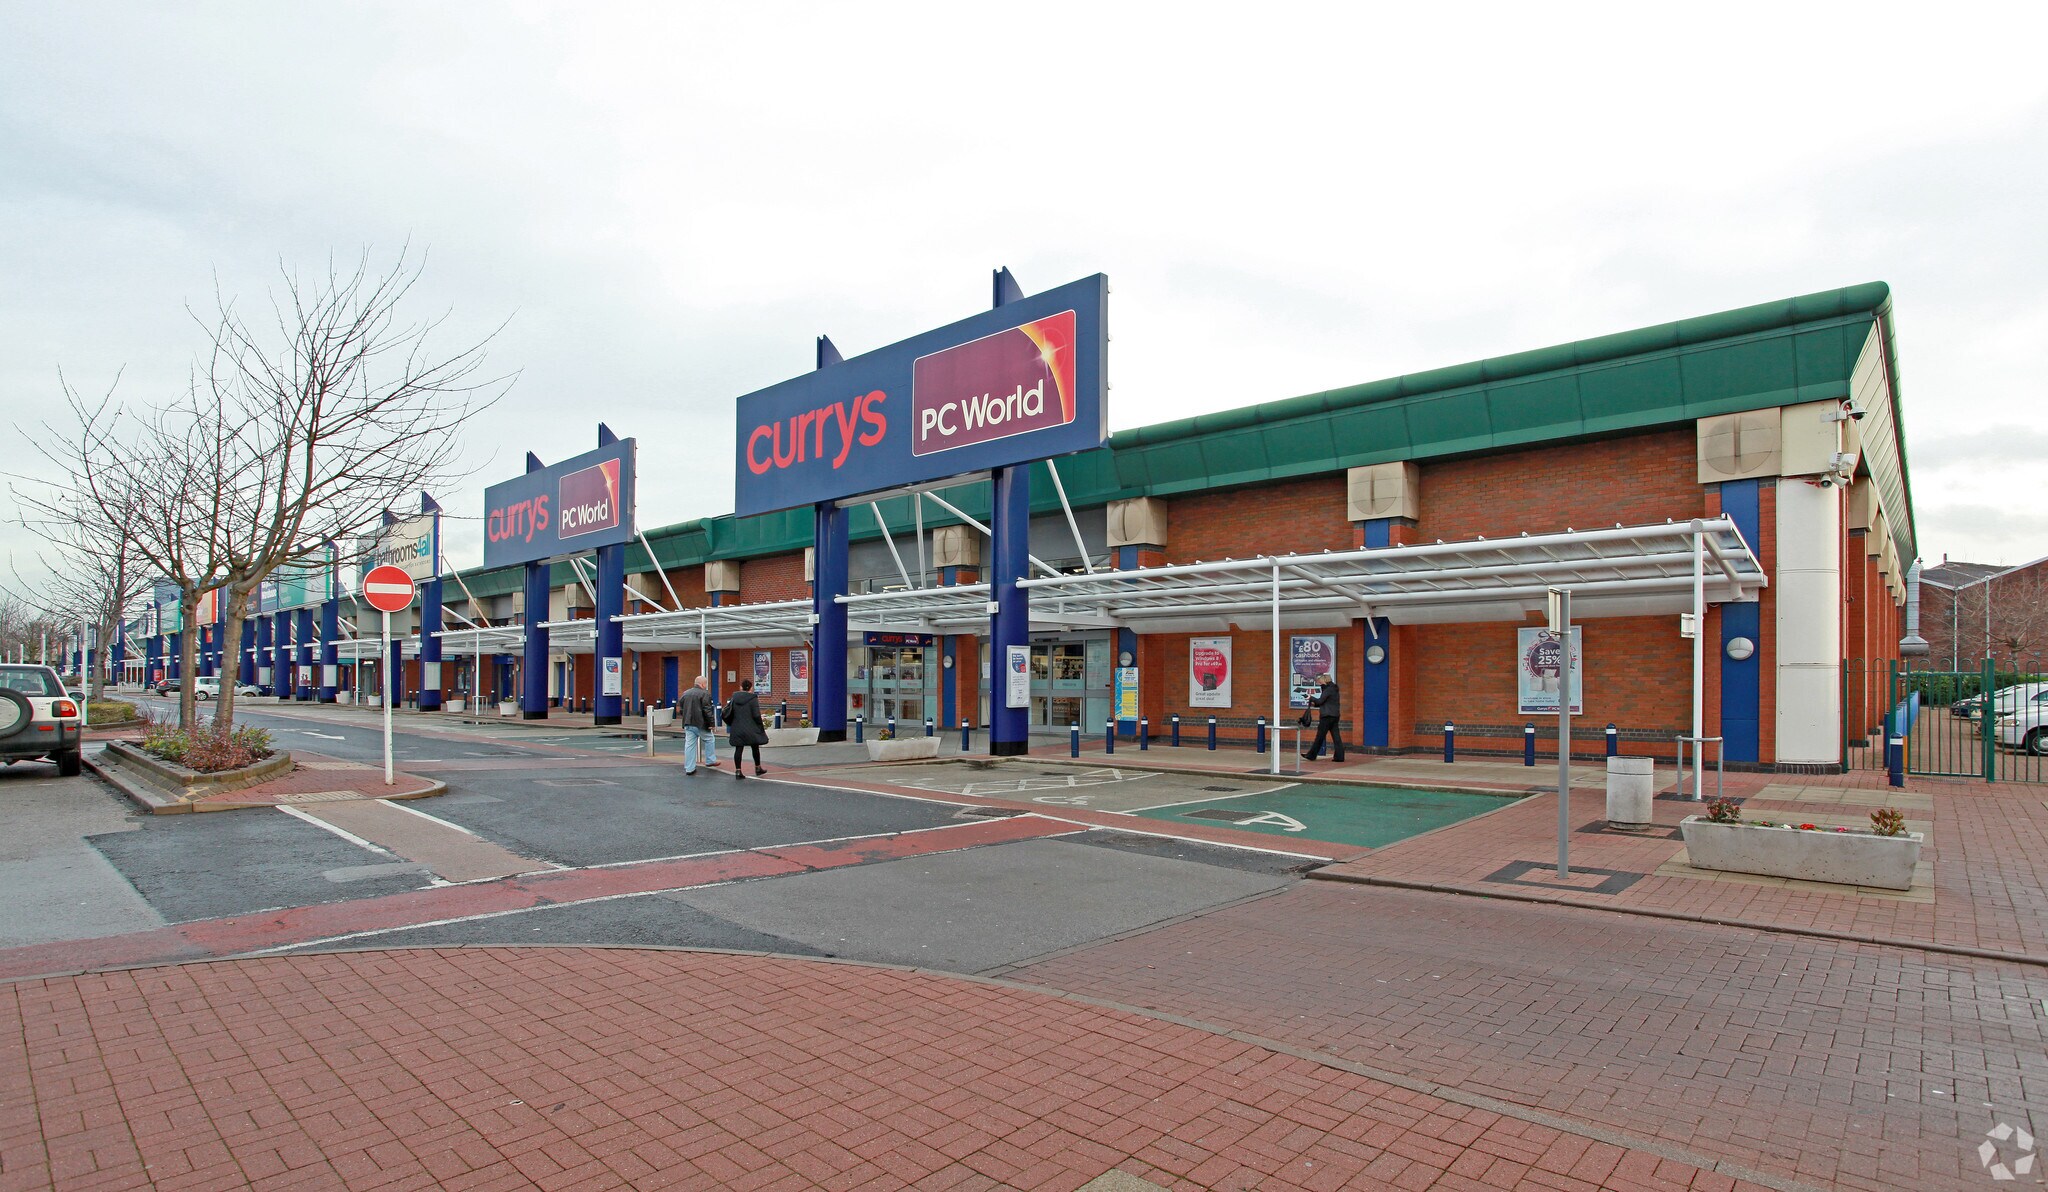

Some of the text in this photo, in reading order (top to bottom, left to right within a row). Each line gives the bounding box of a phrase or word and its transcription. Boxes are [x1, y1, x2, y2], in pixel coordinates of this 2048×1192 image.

[922, 378, 1043, 441] PC World
[747, 390, 887, 475] currys
[488, 494, 549, 543] currys
[562, 498, 608, 530] PC World
[1298, 641, 1321, 652] £80
[1538, 655, 1561, 665] 25%
[1539, 648, 1560, 656] Save
